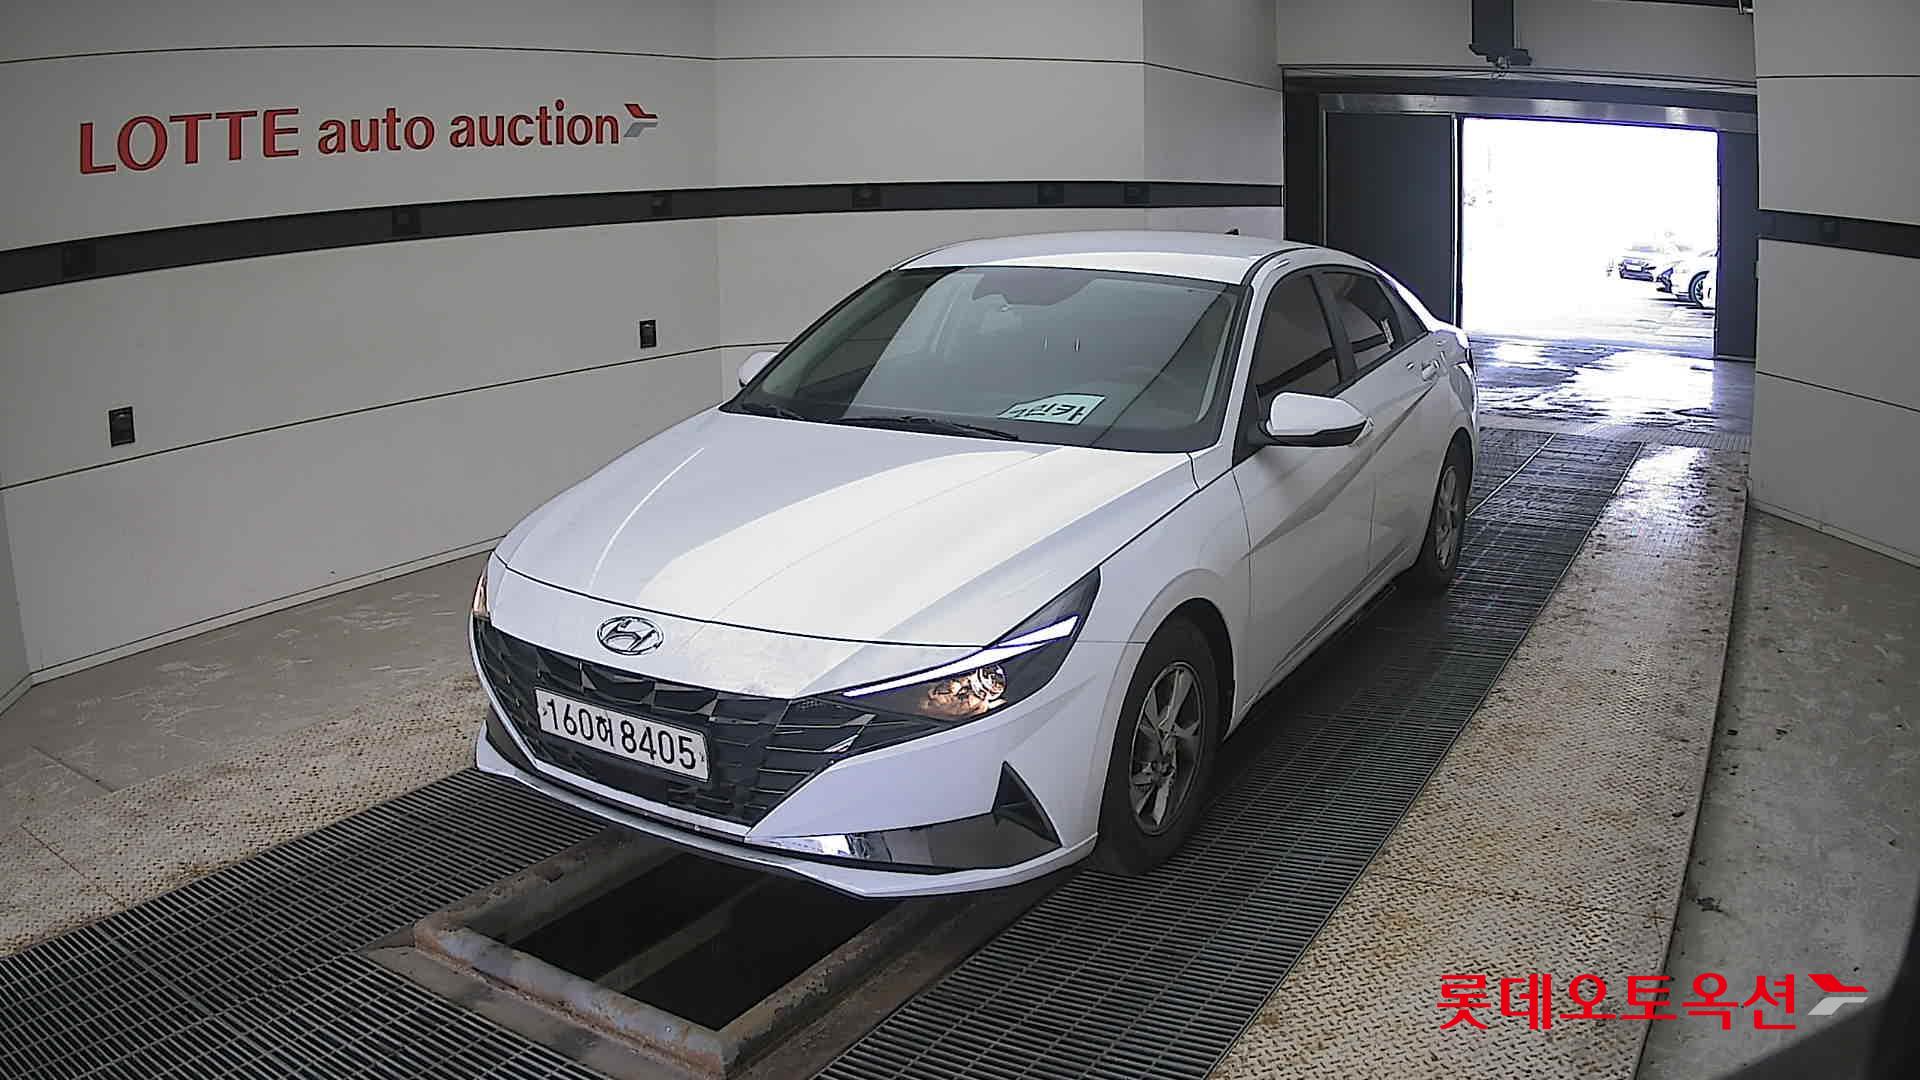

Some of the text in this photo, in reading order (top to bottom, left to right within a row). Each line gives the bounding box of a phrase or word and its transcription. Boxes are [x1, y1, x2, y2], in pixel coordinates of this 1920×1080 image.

[80, 99, 620, 174] LOTTE auto auction
